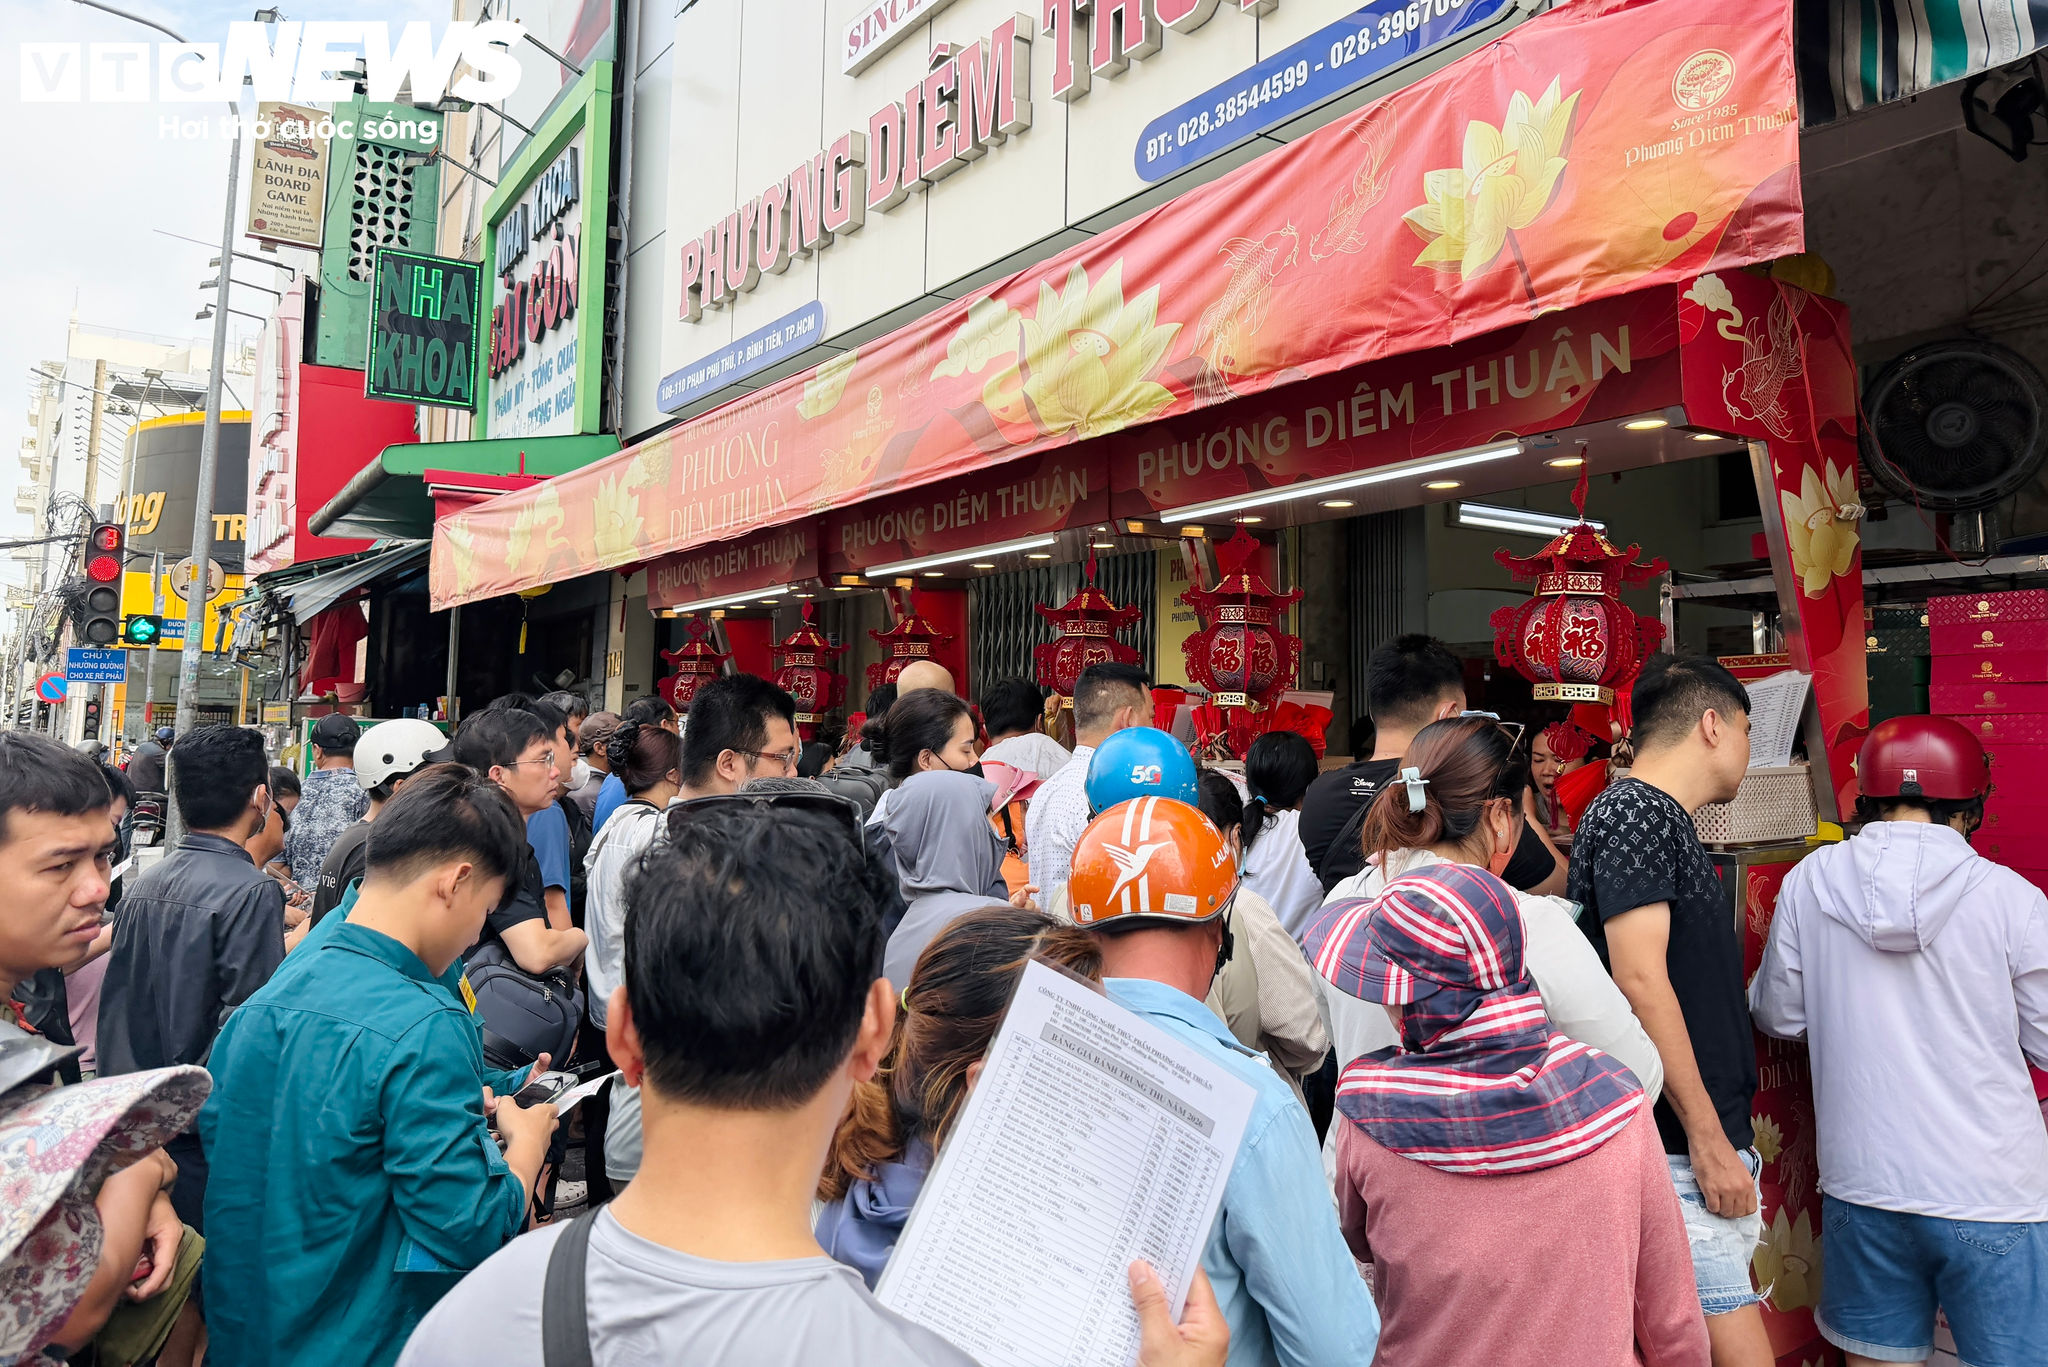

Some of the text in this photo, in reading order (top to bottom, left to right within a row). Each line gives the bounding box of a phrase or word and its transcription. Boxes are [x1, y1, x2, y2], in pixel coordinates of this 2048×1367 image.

[1146, 132, 1173, 163] ĐT:
[1177, 58, 1309, 148] 028.38544599
[1671, 103, 1738, 132] Since 1985
[256, 157, 321, 181] LÃNH ĐỊA
[264, 174, 312, 192] BOARD
[266, 189, 308, 206] GAME
[532, 146, 578, 241] KHOA
[679, 130, 862, 321] PHƯƠNG
[867, 17, 1032, 212] DIÊM
[381, 261, 471, 325] NHA
[375, 330, 470, 399] KHOA
[686, 370, 706, 391] PHẠM
[738, 352, 746, 366] P.
[746, 340, 764, 362] BÌNH
[785, 313, 815, 342] TP.HCM
[1137, 323, 1631, 487] PHƯƠNG DIÊM THUẬN
[681, 421, 779, 495] PHƯƠNG
[841, 466, 1089, 552] PHƯƠNG DIÊM THUẬN
[656, 525, 806, 593] PHƯƠNG DIÊM THUẬN
[82, 649, 112, 660] CHÚ Ý
[1562, 614, 1606, 662] 福
[85, 672, 94, 680] XE
[1130, 765, 1162, 785] 5G
[1352, 776, 1376, 789] Disney
[322, 871, 336, 889] vie
[1050, 1030, 1077, 1052] BẢNG
[1075, 1043, 1094, 1060] GIÁ
[1093, 1053, 1119, 1075] BÁNH
[1118, 1069, 1148, 1092] TRUNG
[1165, 1098, 1188, 1117] NĂM
[1185, 1112, 1205, 1128] 2026
